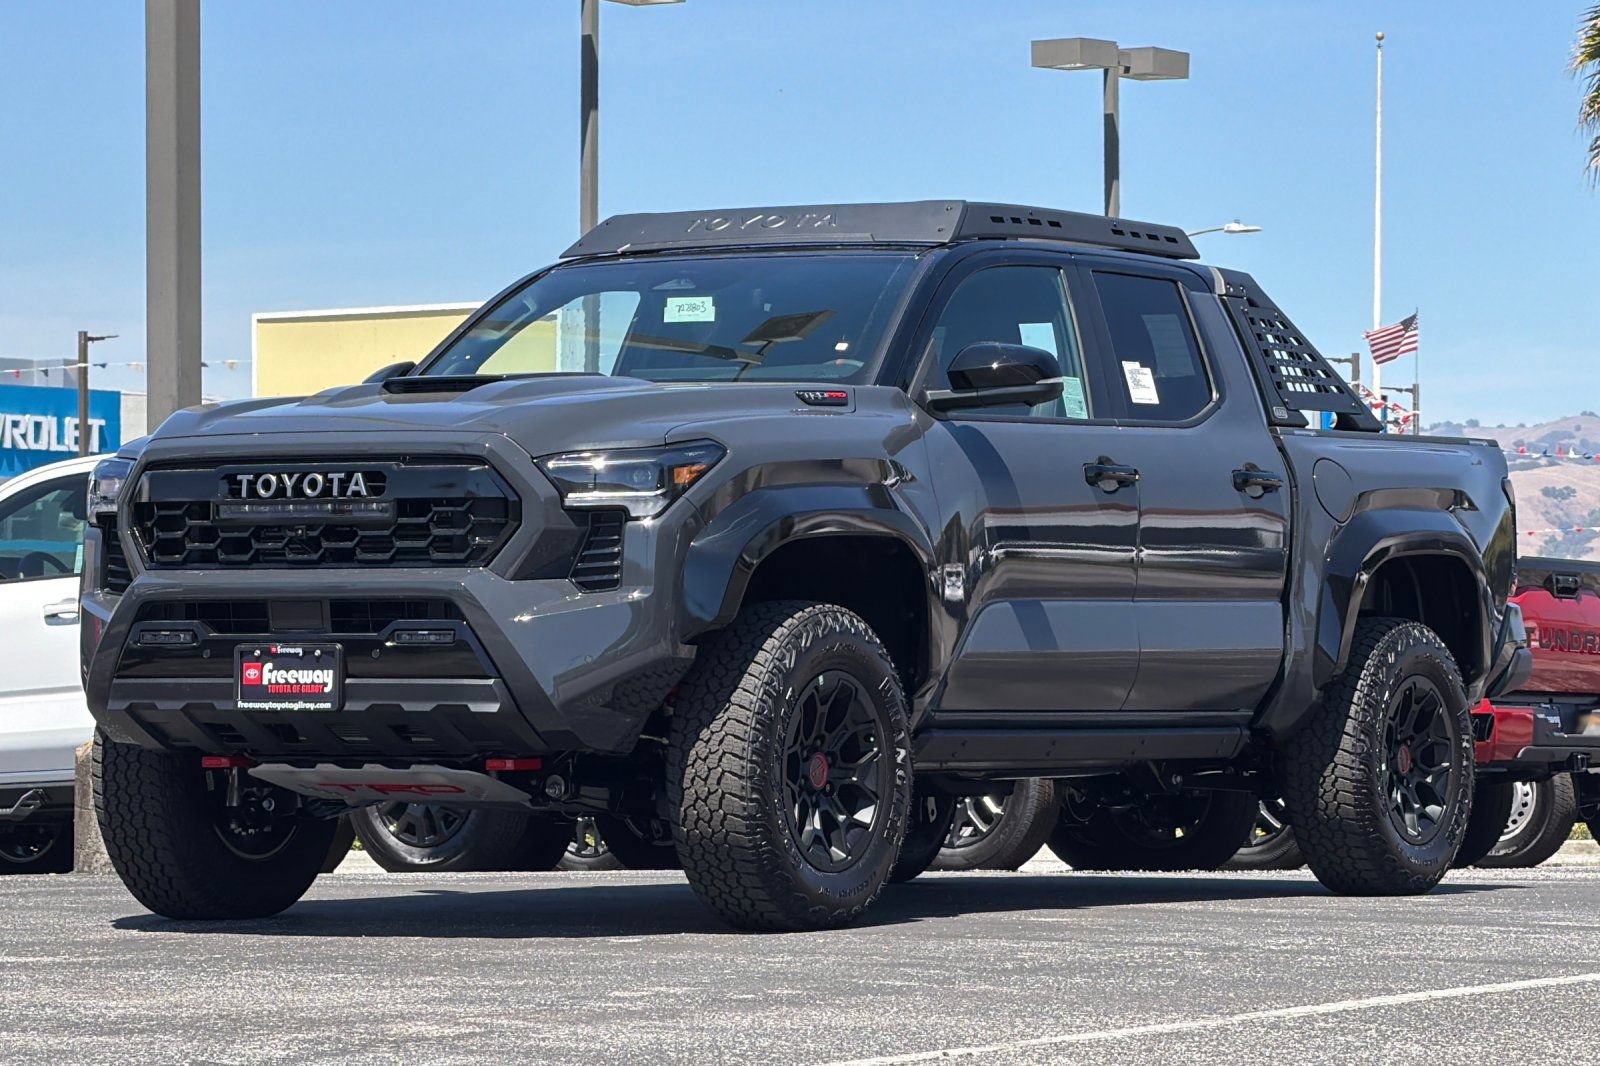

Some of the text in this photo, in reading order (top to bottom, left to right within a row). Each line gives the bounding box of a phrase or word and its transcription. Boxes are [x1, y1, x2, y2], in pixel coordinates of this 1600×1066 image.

[686, 212, 838, 233] TOYOTA
[0, 412, 106, 453] ROLET
[236, 472, 368, 498] TOYOTA
[1524, 626, 1600, 653] TUNDR
[277, 645, 303, 656] freeway
[262, 662, 334, 693] freeway
[268, 684, 323, 693] TOYOTA OF GILROY
[237, 701, 332, 710] freewaytoyotagilroy.com
[318, 782, 465, 796] TRD
